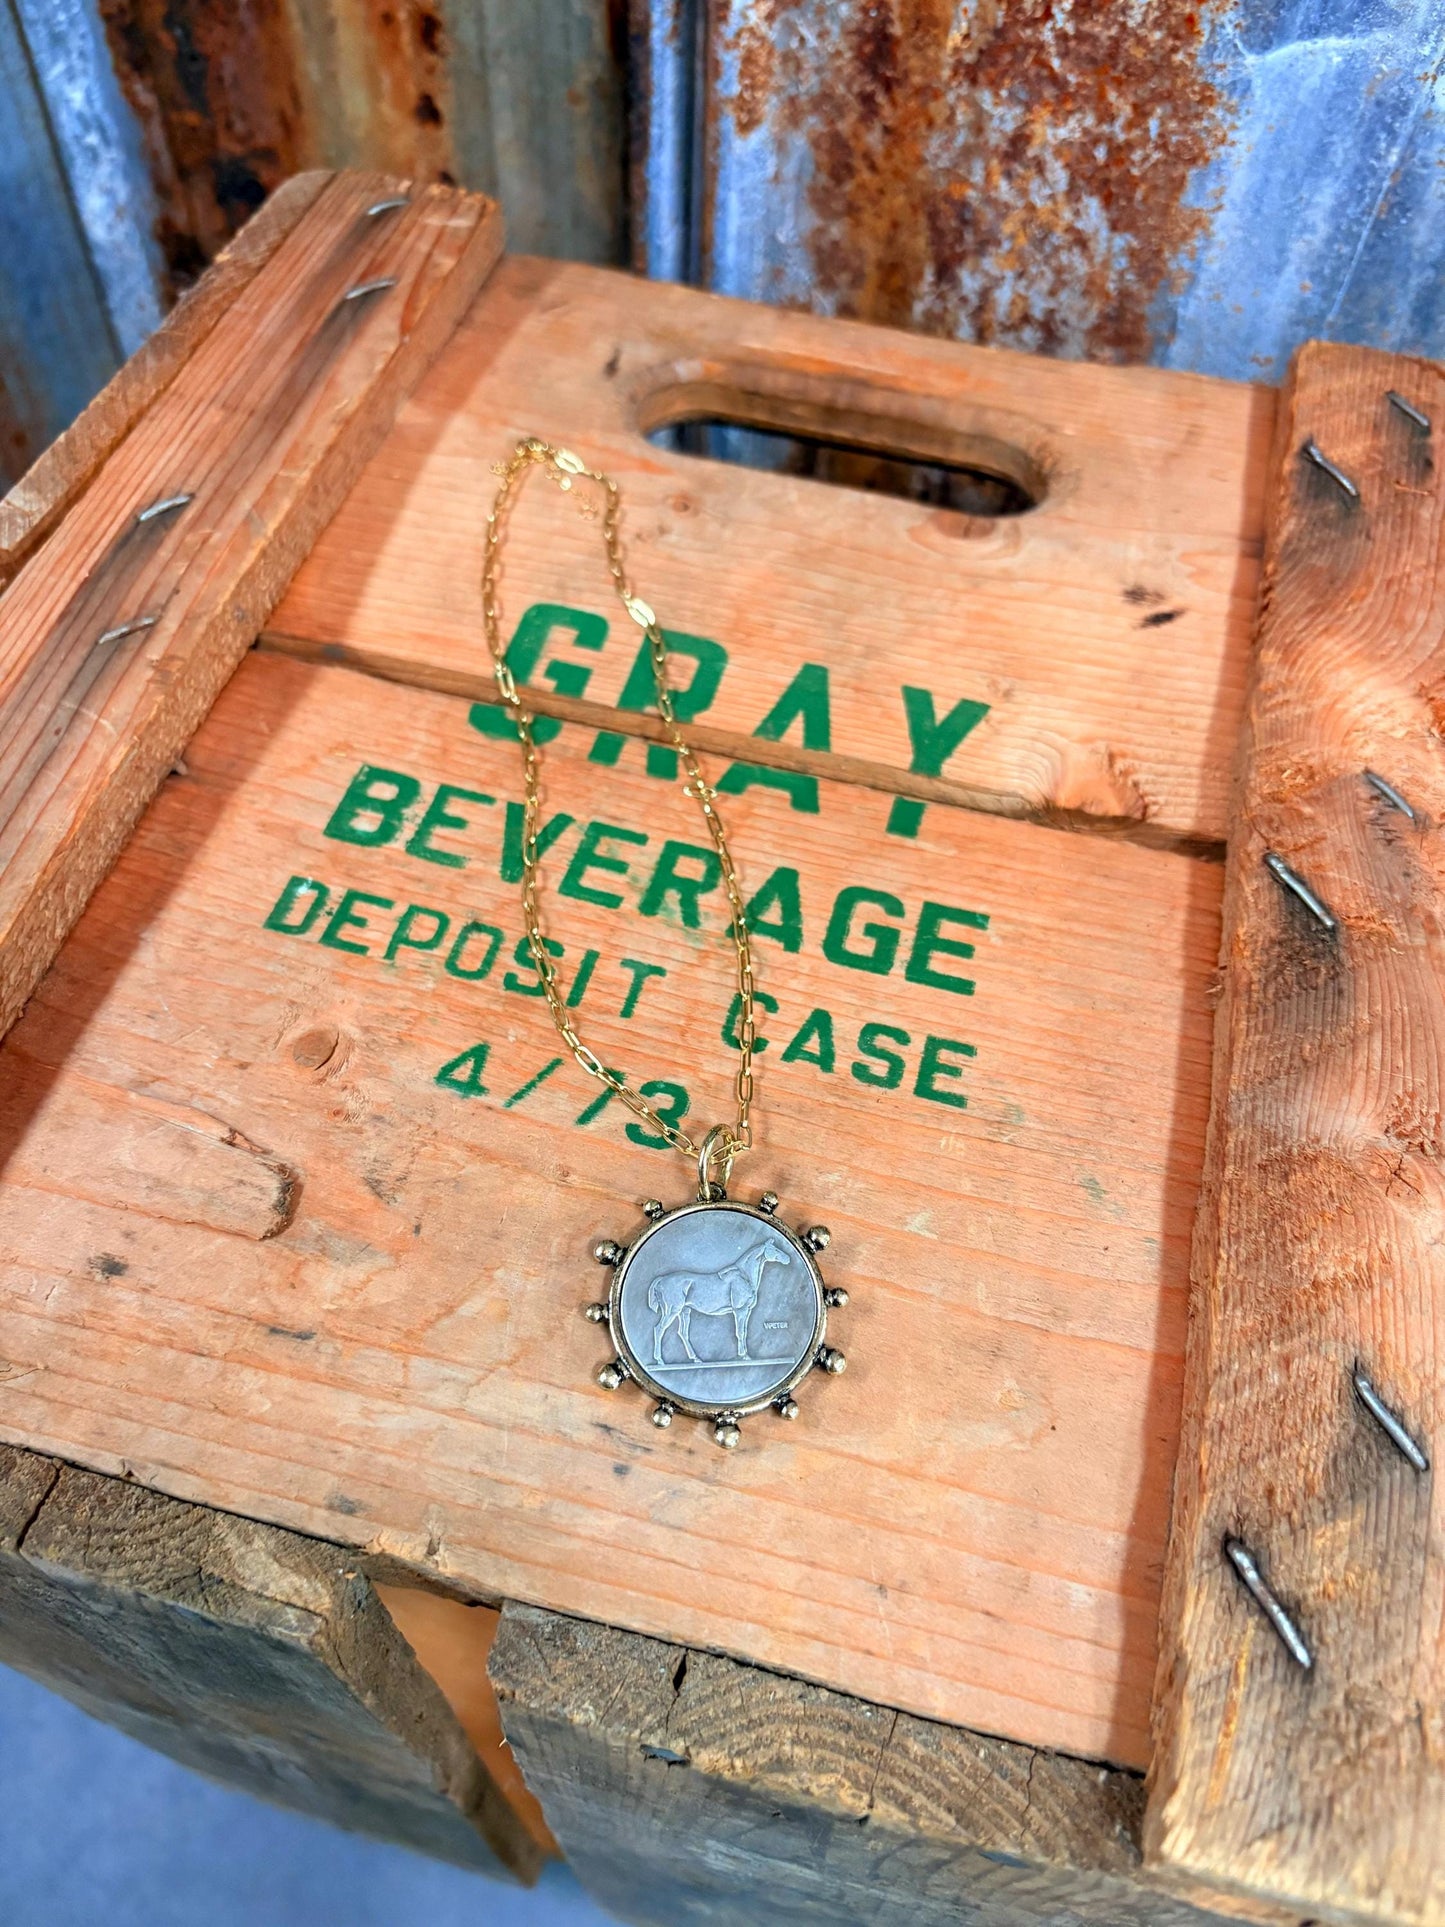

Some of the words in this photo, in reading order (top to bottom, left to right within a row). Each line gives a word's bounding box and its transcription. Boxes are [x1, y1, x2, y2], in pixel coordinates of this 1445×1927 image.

[469, 602, 990, 838] GRAY
[263, 876, 667, 1019] DEPOSIT
[721, 992, 977, 1109] CASE
[324, 765, 990, 996] BEVERAGE
